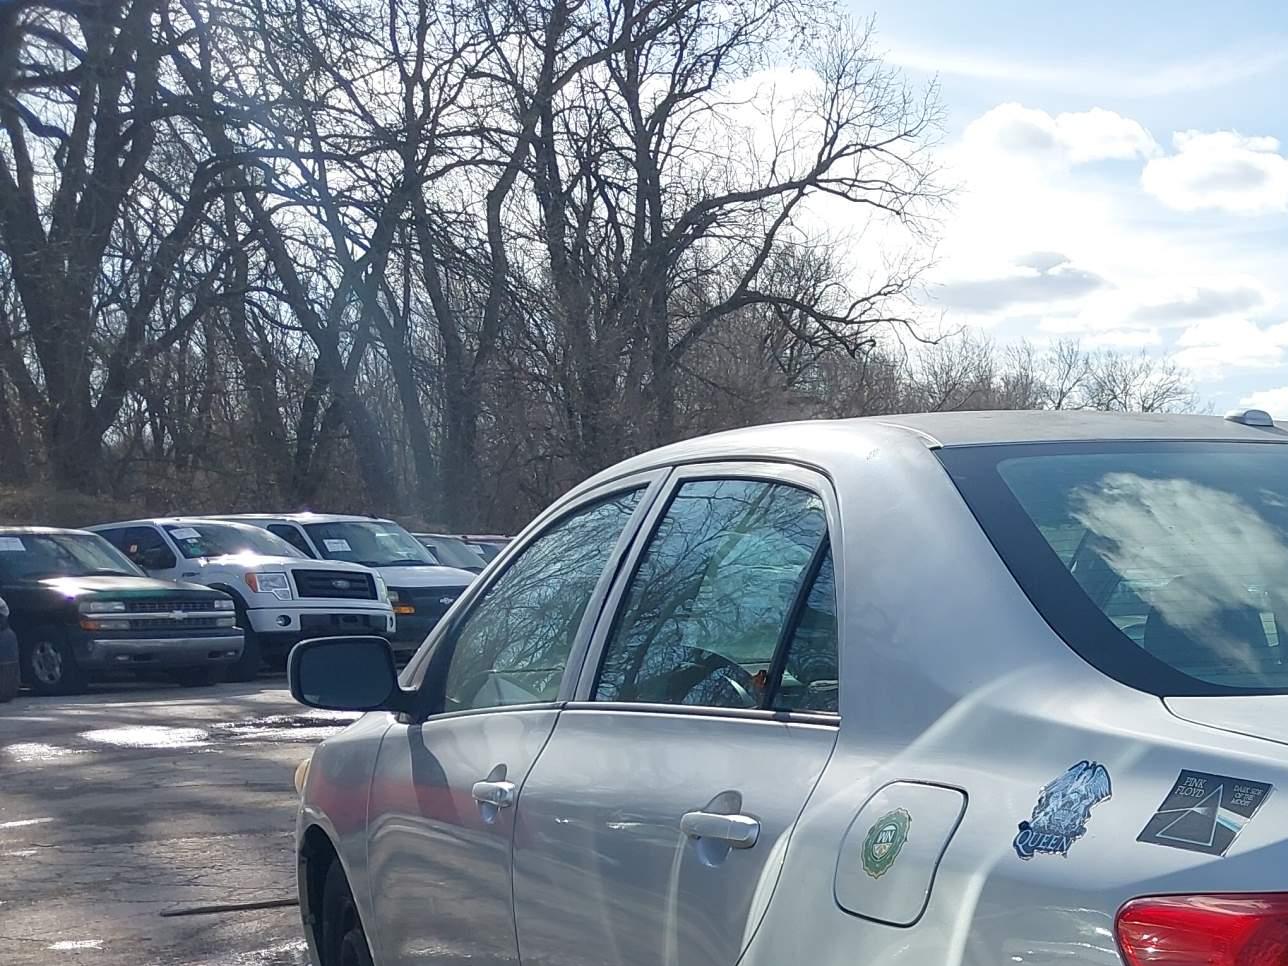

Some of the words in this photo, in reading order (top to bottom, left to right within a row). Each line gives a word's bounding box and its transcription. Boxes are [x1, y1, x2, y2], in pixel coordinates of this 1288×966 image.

[1183, 776, 1208, 790] PINK
[1174, 786, 1205, 798] FLOYD
[1016, 829, 1072, 856] QUEEN
